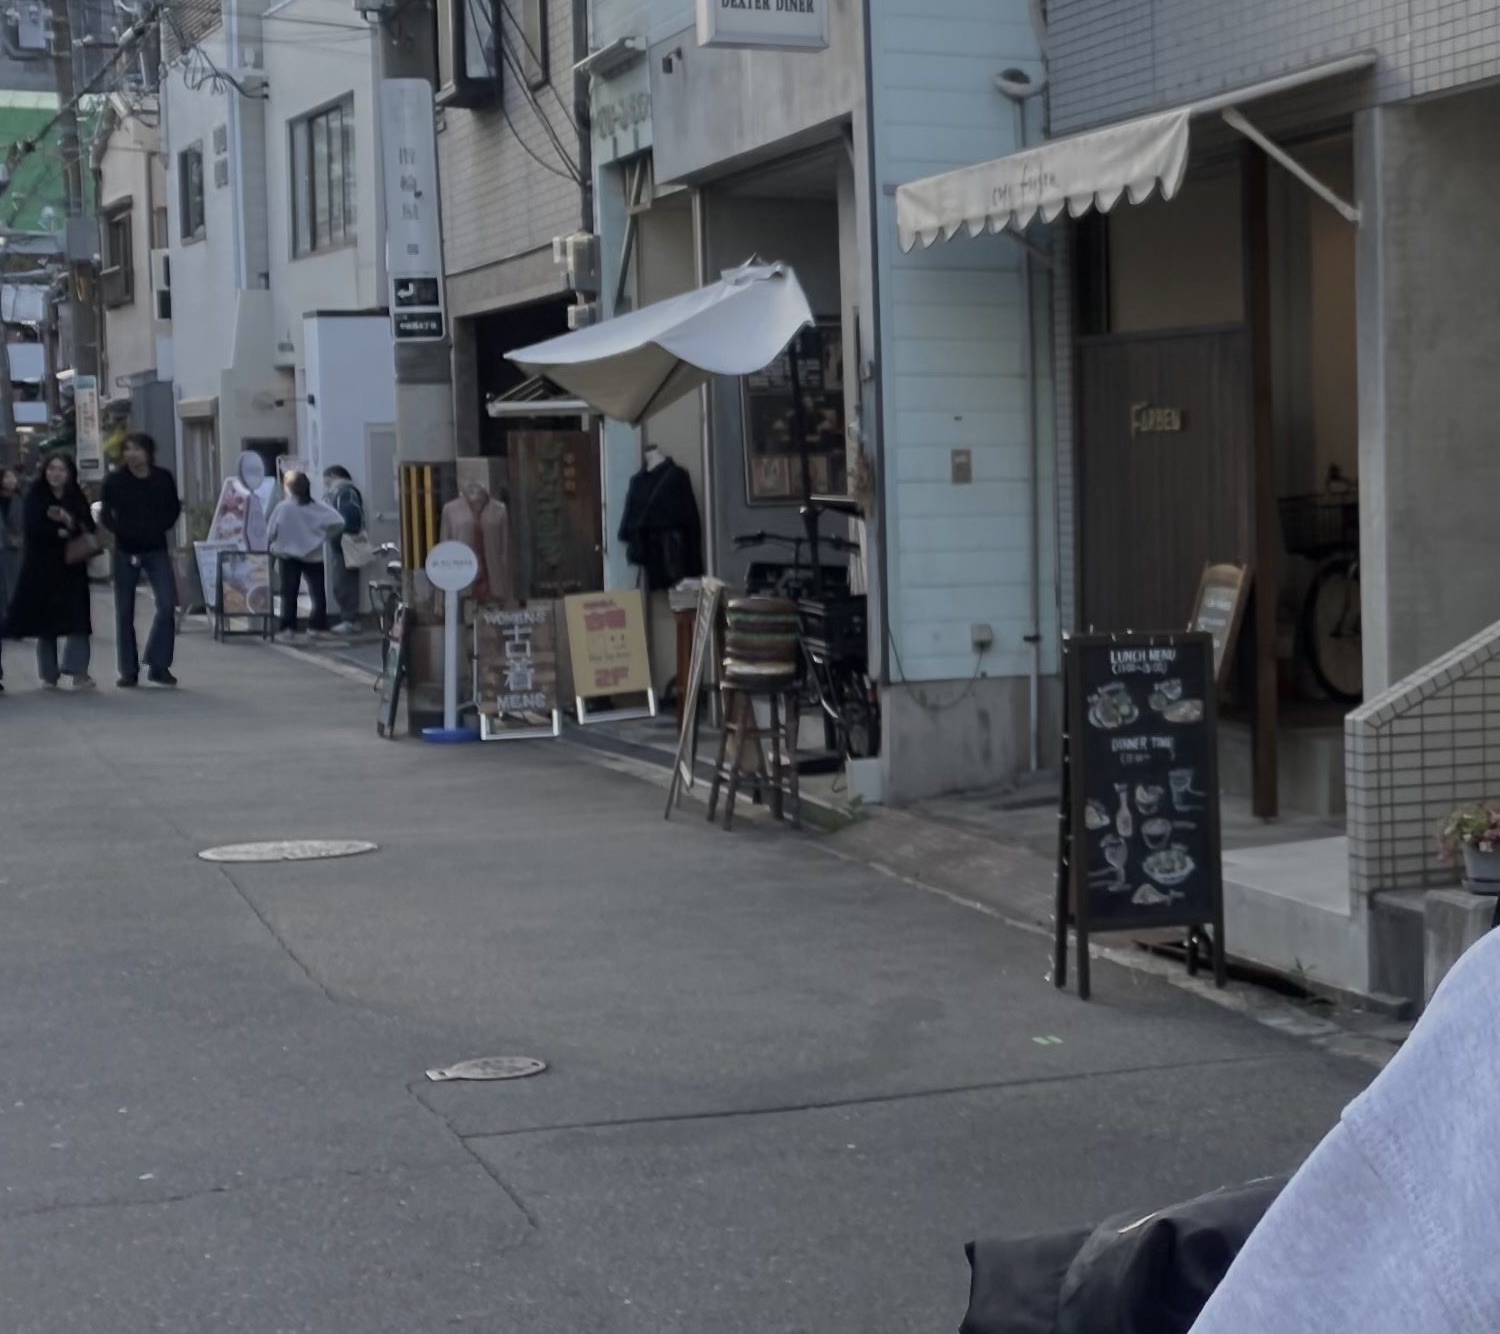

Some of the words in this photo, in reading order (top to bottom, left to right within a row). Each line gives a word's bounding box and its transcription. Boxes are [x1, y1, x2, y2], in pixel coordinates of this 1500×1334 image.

[502, 625, 535, 692] 古着
[1110, 649, 1147, 665] LUNCH
[1148, 648, 1177, 662] MENU
[496, 692, 546, 711] MENS
